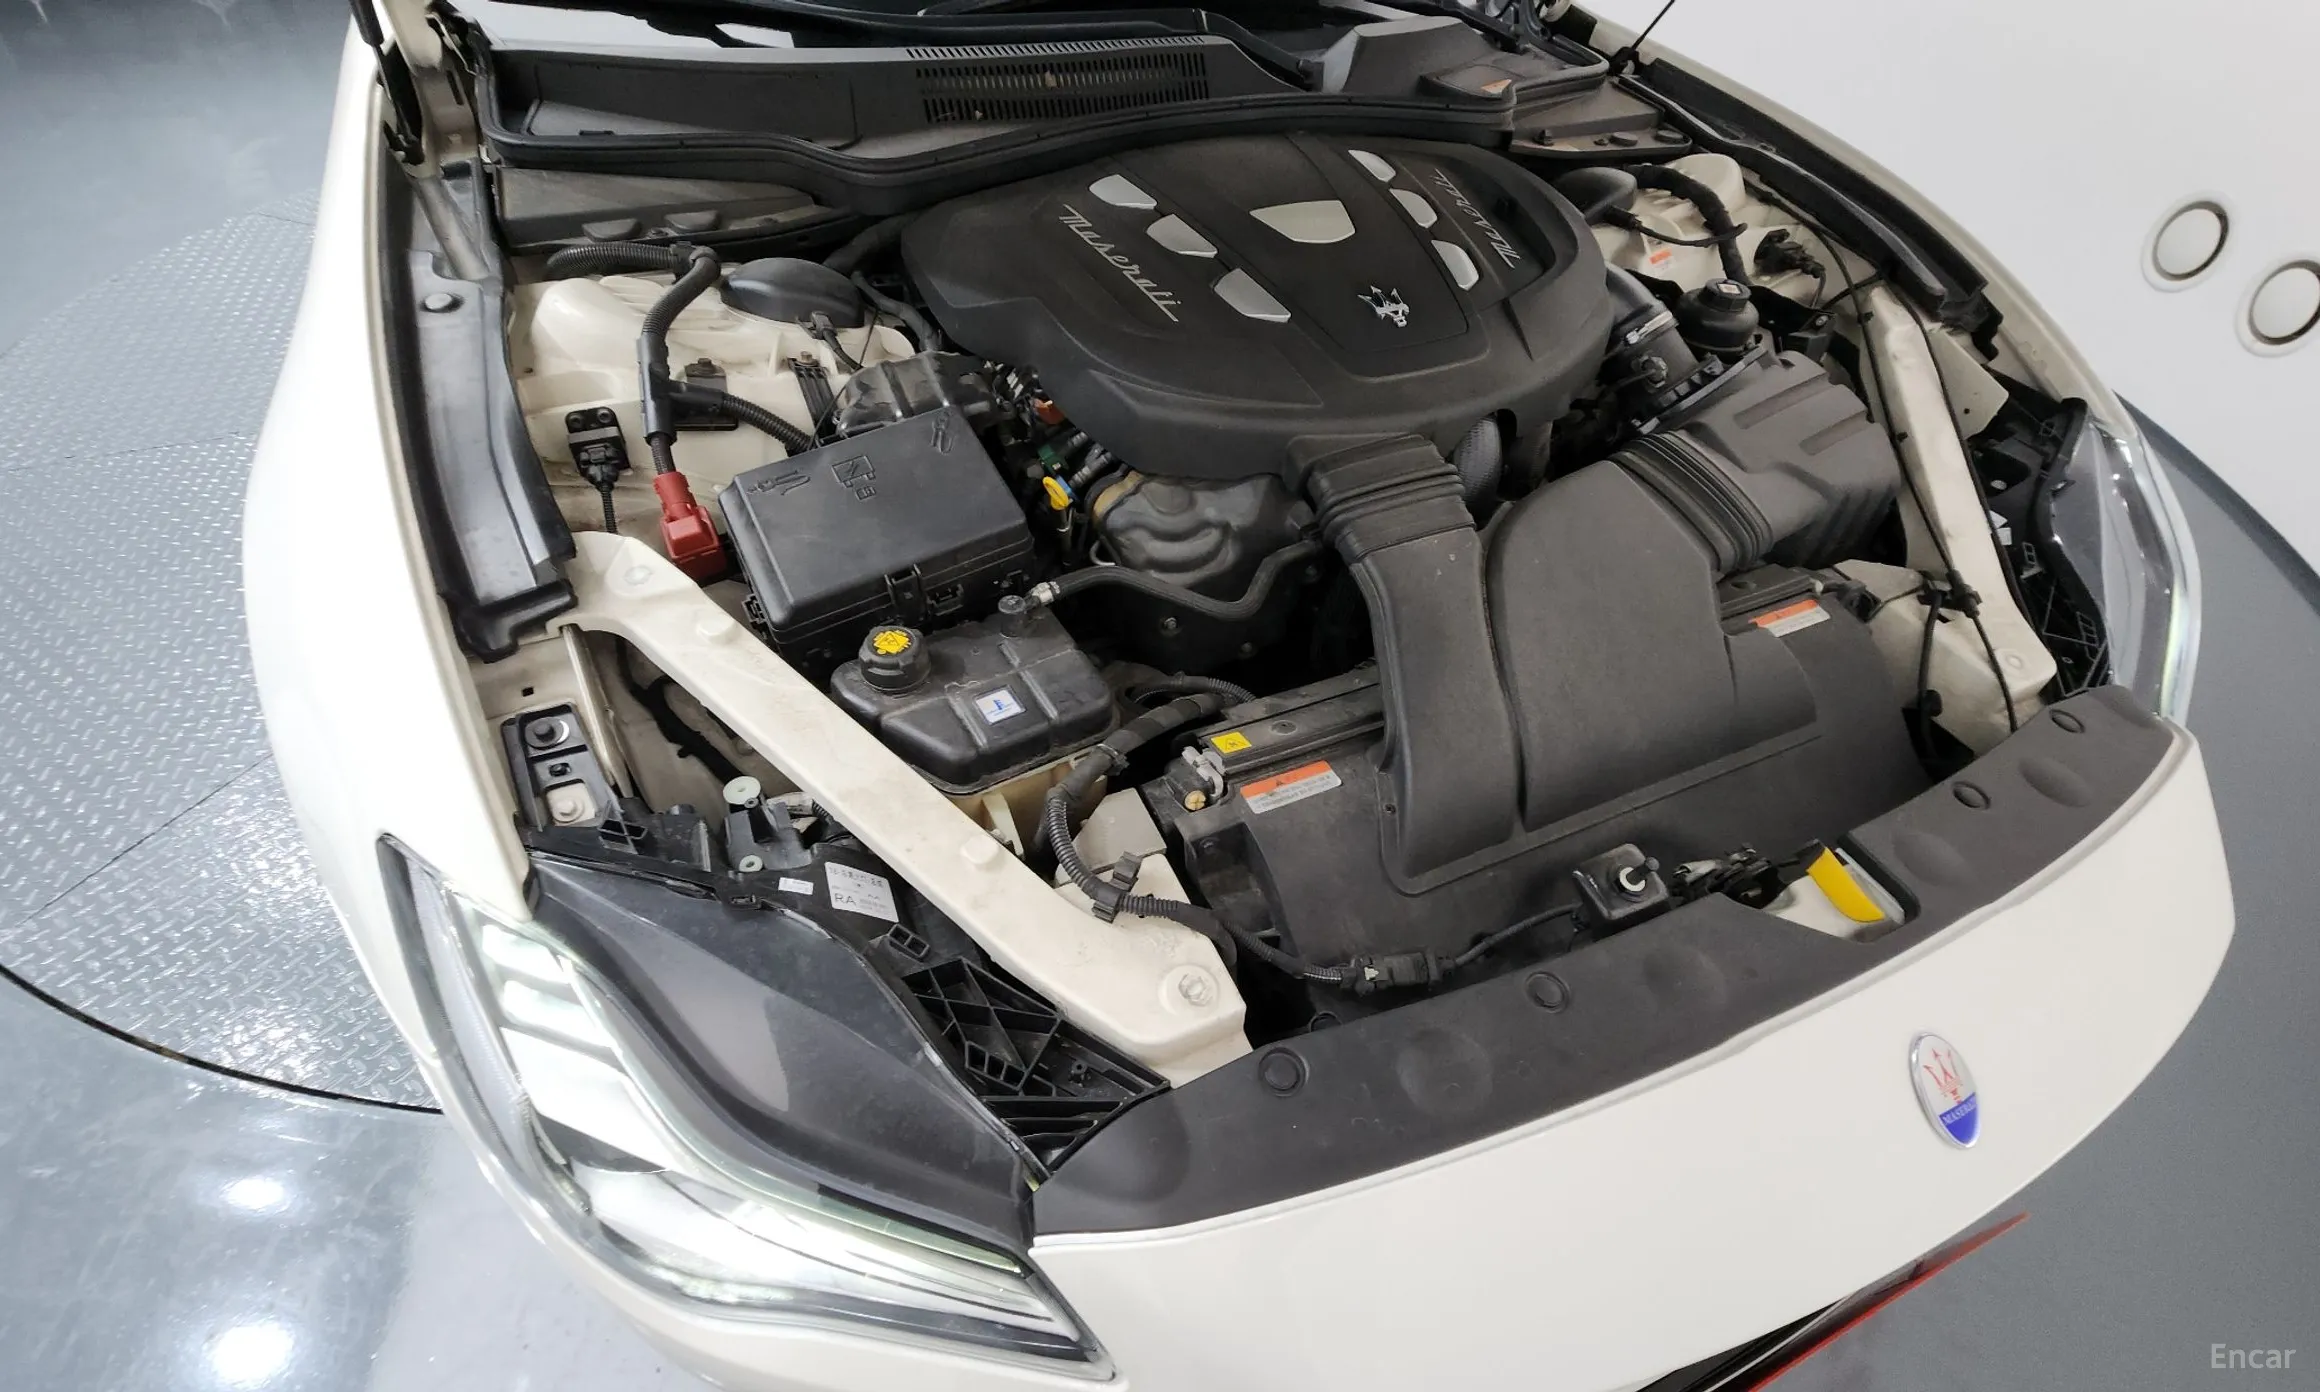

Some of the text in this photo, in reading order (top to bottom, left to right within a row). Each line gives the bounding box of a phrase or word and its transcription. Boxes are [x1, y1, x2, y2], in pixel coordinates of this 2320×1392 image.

[1058, 203, 1181, 323] Maserati
[1429, 168, 1521, 269] Maserati
[834, 892, 857, 905] RA
